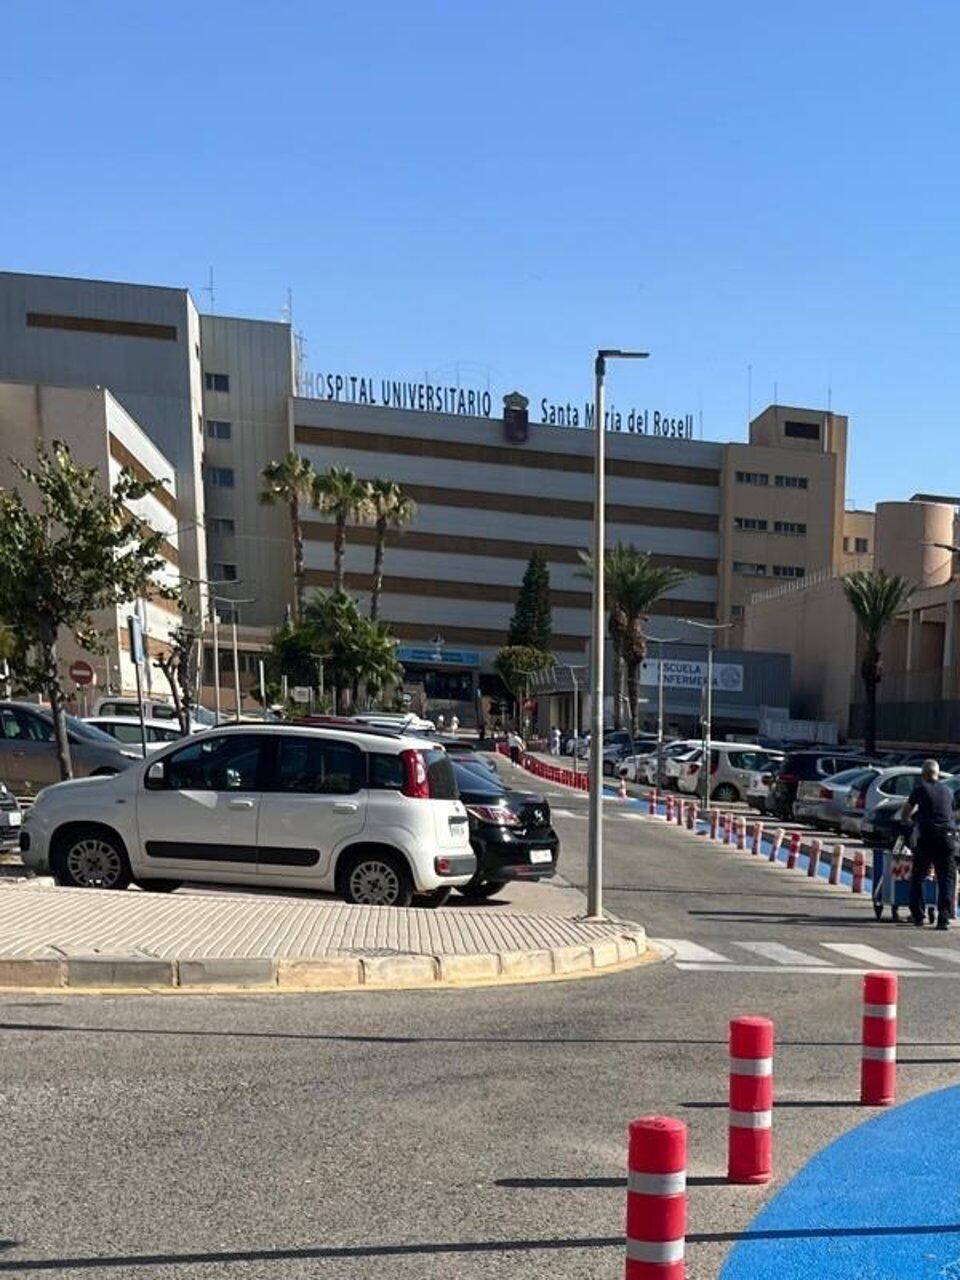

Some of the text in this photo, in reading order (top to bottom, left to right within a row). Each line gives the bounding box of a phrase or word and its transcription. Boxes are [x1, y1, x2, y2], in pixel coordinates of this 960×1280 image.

[304, 371, 491, 416] HOSPITAL UNIVERSITARIO
[541, 398, 578, 426] Santa
[628, 409, 648, 434] del
[653, 411, 693, 439] Rosell
[658, 662, 702, 674] SCUELA
